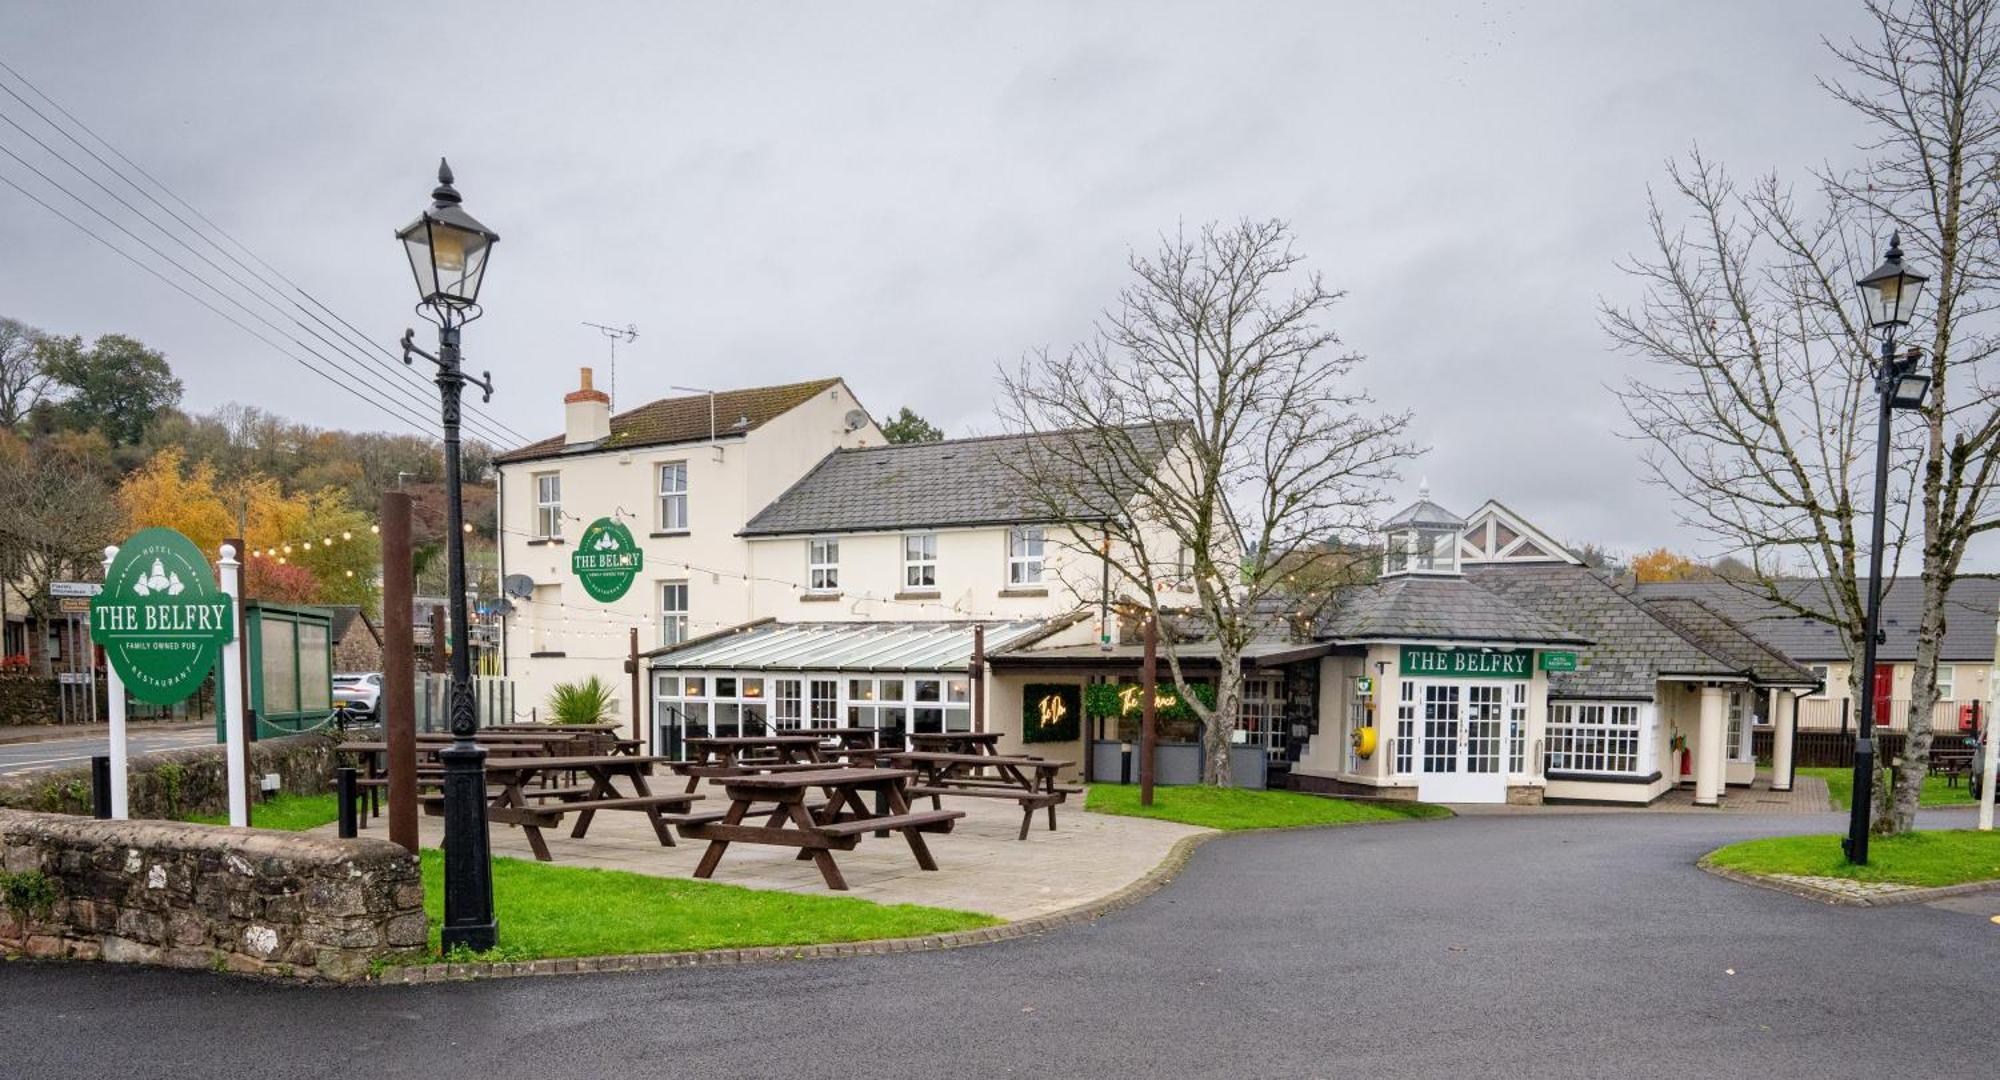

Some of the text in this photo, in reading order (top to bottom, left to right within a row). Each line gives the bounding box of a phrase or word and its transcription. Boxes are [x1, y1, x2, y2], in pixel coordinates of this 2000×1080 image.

[142, 545, 172, 556] HOTEL
[575, 555, 596, 568] THE
[96, 604, 226, 630] THE BELFRY
[126, 642, 196, 650] FAMILY OWNED PUB
[1408, 651, 1526, 673] THE BELFRY
[131, 664, 192, 687] RESTAURANT
